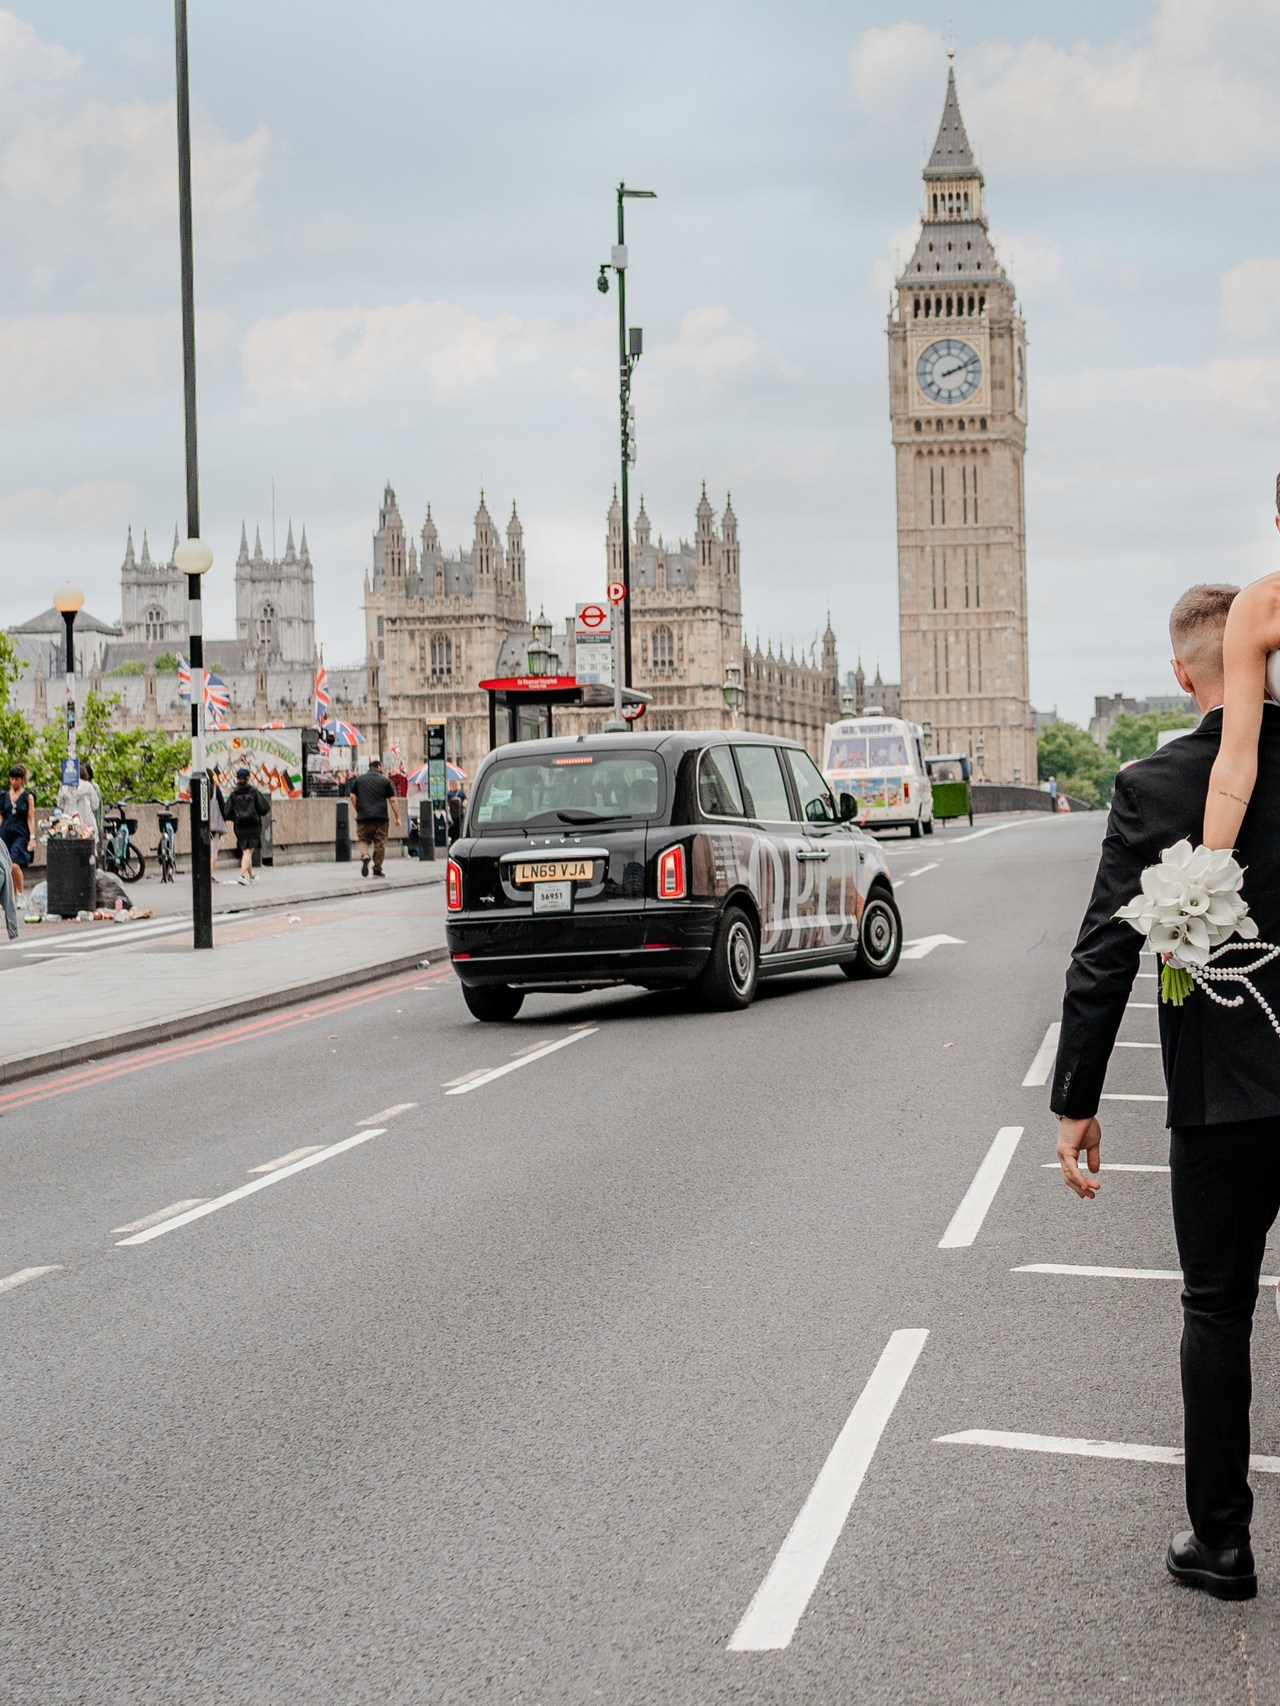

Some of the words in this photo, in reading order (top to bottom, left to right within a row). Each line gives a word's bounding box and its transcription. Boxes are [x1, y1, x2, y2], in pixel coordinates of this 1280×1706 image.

[609, 585, 624, 600] D
[521, 864, 557, 879] LN69
[561, 863, 586, 876] VJA
